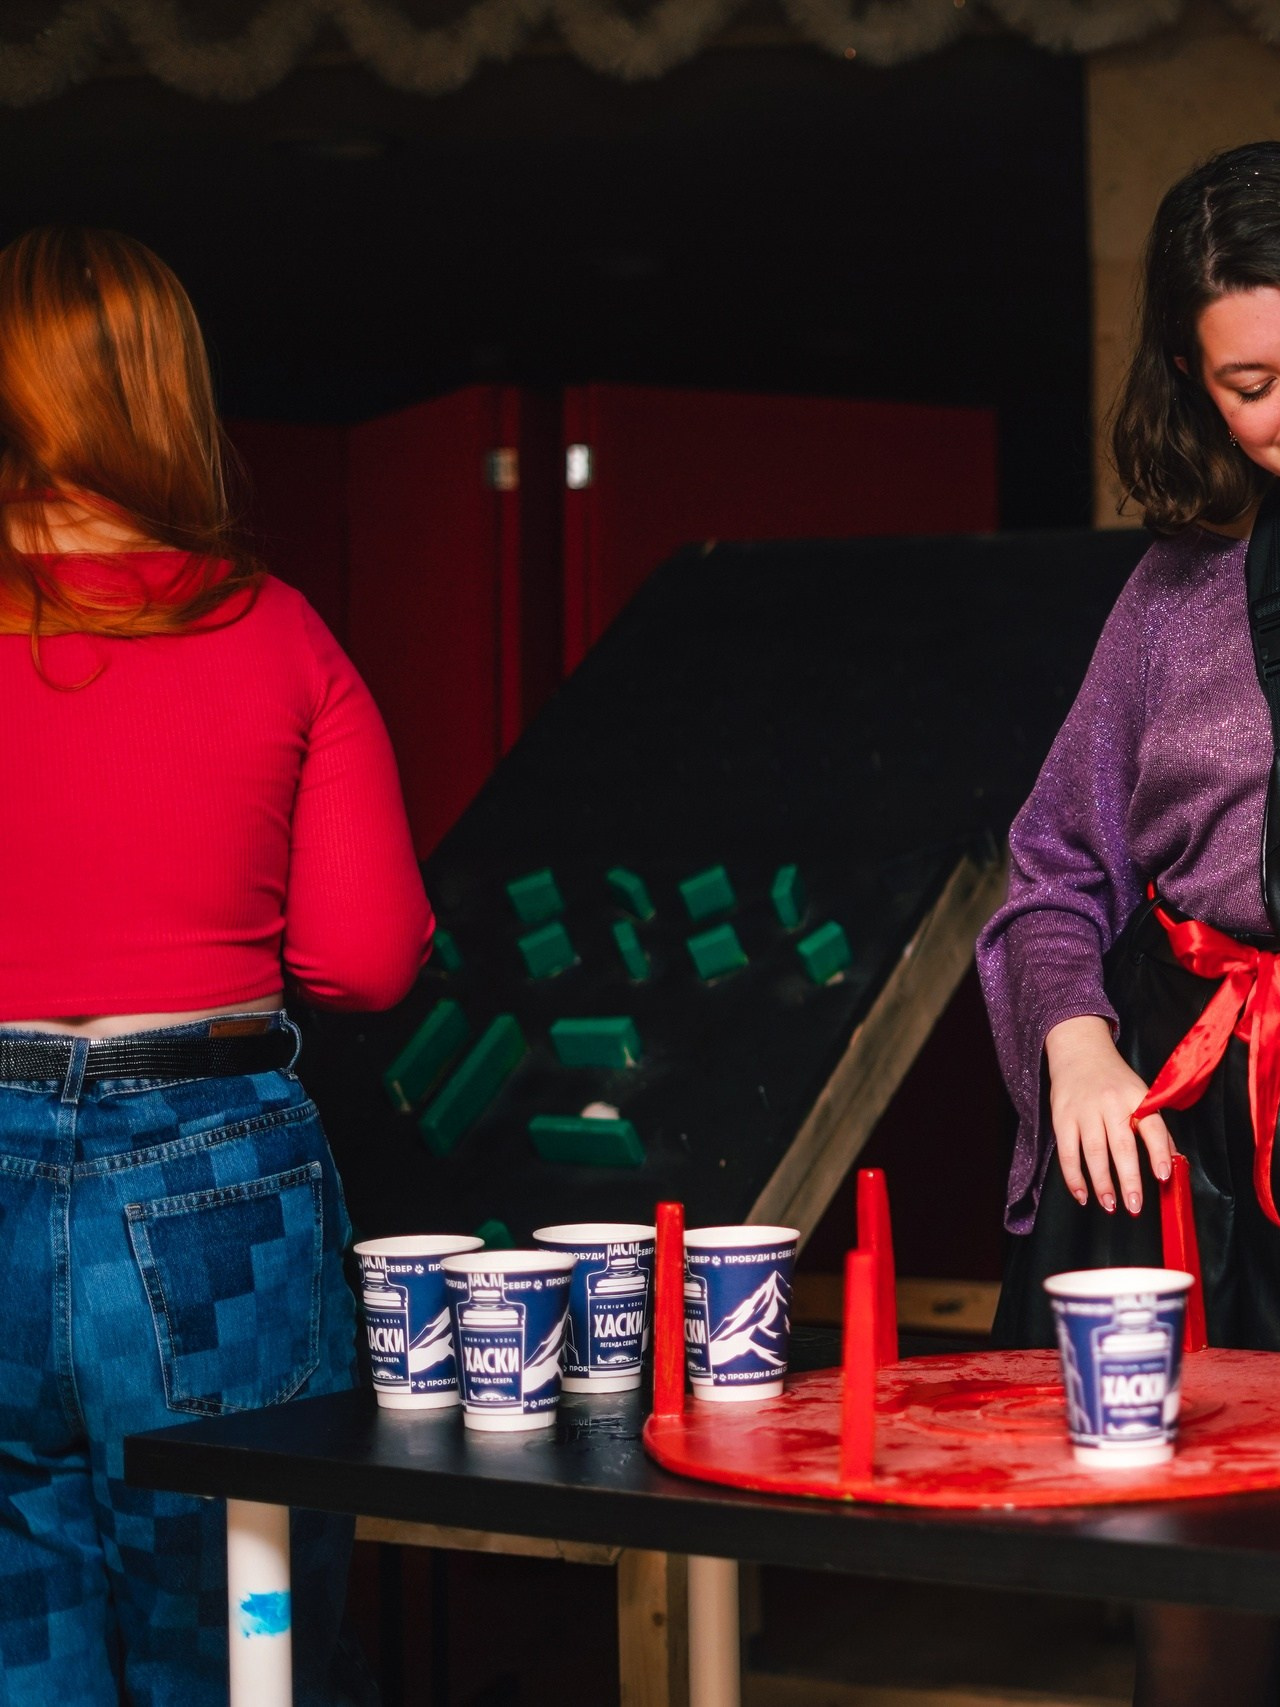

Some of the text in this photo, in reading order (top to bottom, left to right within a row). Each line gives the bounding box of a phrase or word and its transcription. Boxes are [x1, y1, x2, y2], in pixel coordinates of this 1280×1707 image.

[724, 1253, 770, 1264] ПРОБУДИ
[385, 1264, 413, 1273] СЕВЕР
[503, 1281, 532, 1290] СЕВЕР
[594, 1310, 644, 1338] ХАСКИ
[464, 1346, 519, 1374] ХАСКИ
[727, 1370, 765, 1380] ПРОБУДИ
